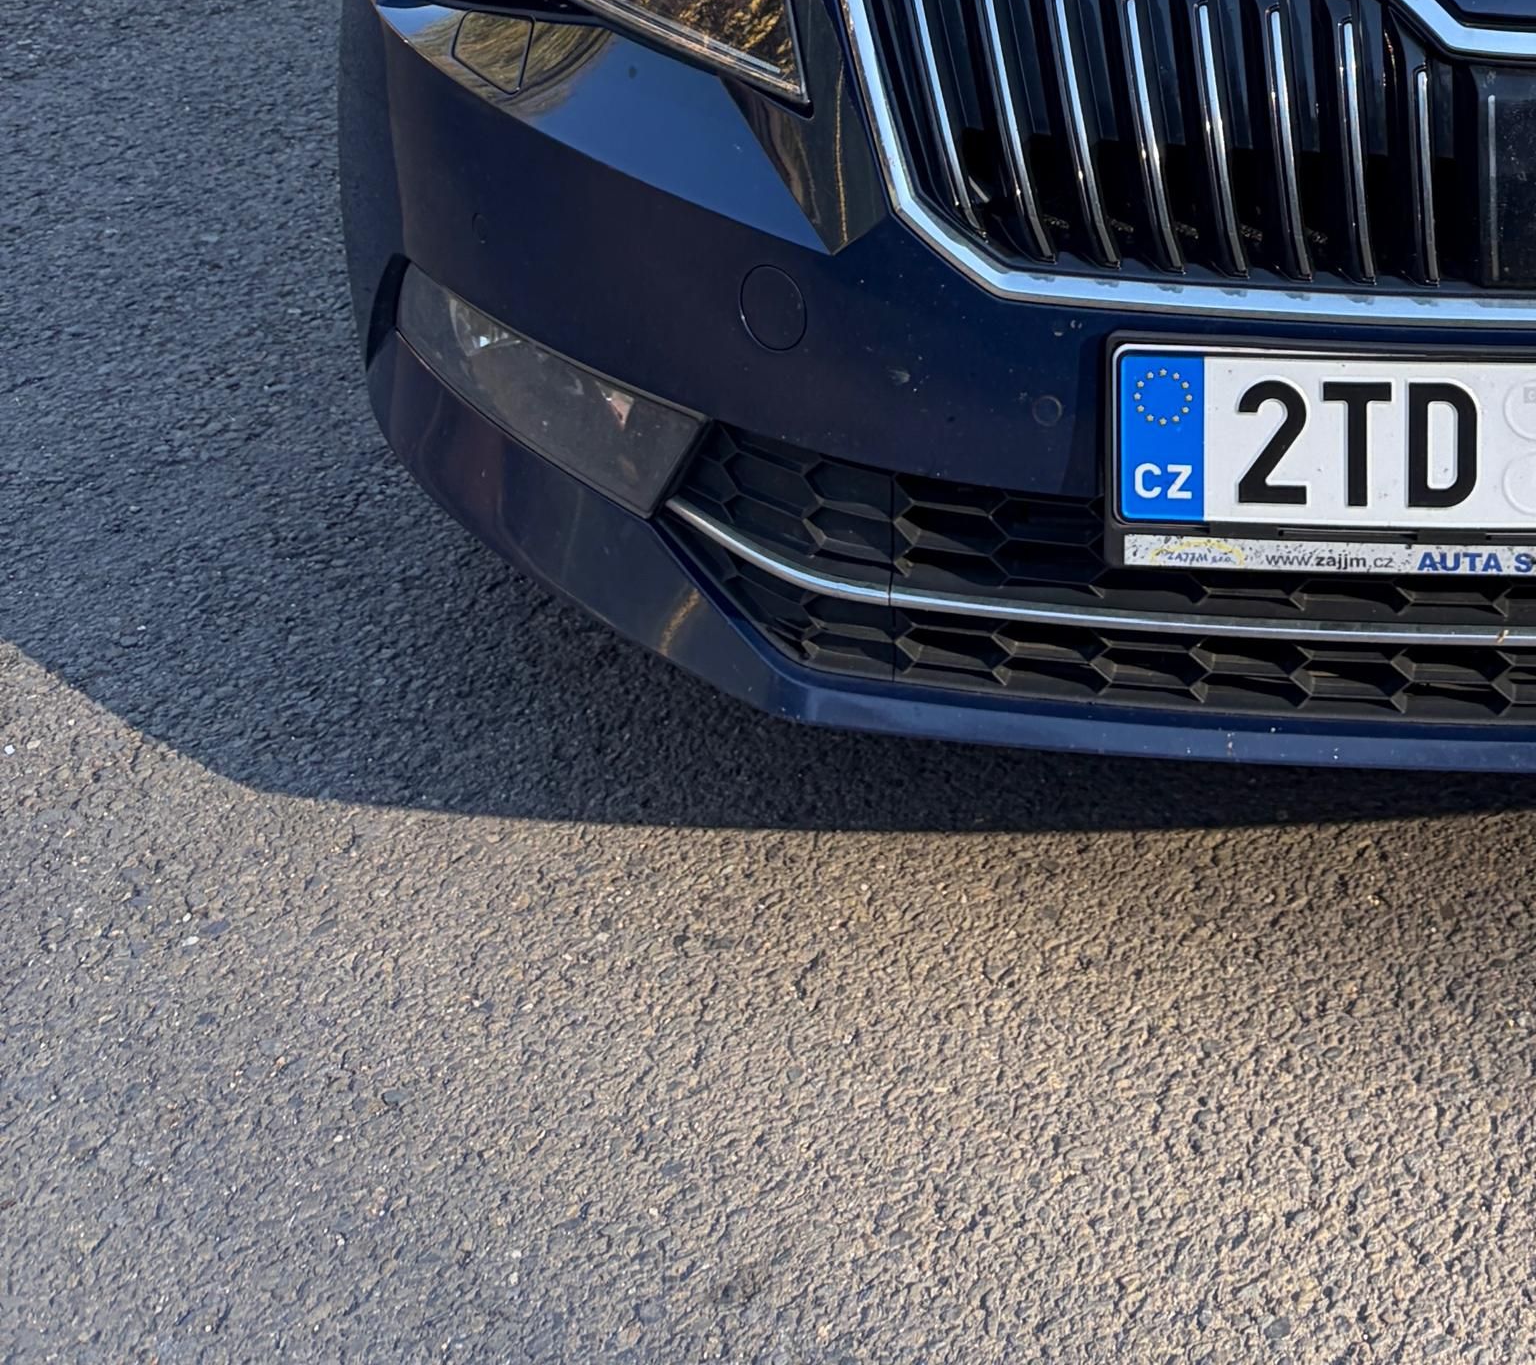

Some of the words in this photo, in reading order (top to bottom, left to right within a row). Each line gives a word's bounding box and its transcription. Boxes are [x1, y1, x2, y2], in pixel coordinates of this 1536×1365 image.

[1236, 379, 1478, 509] 2TD
[1133, 461, 1193, 499] CZ
[1265, 553, 1394, 570] www.zajjm.cz
[1417, 551, 1503, 572] AUTA
[1514, 552, 1533, 574] S
